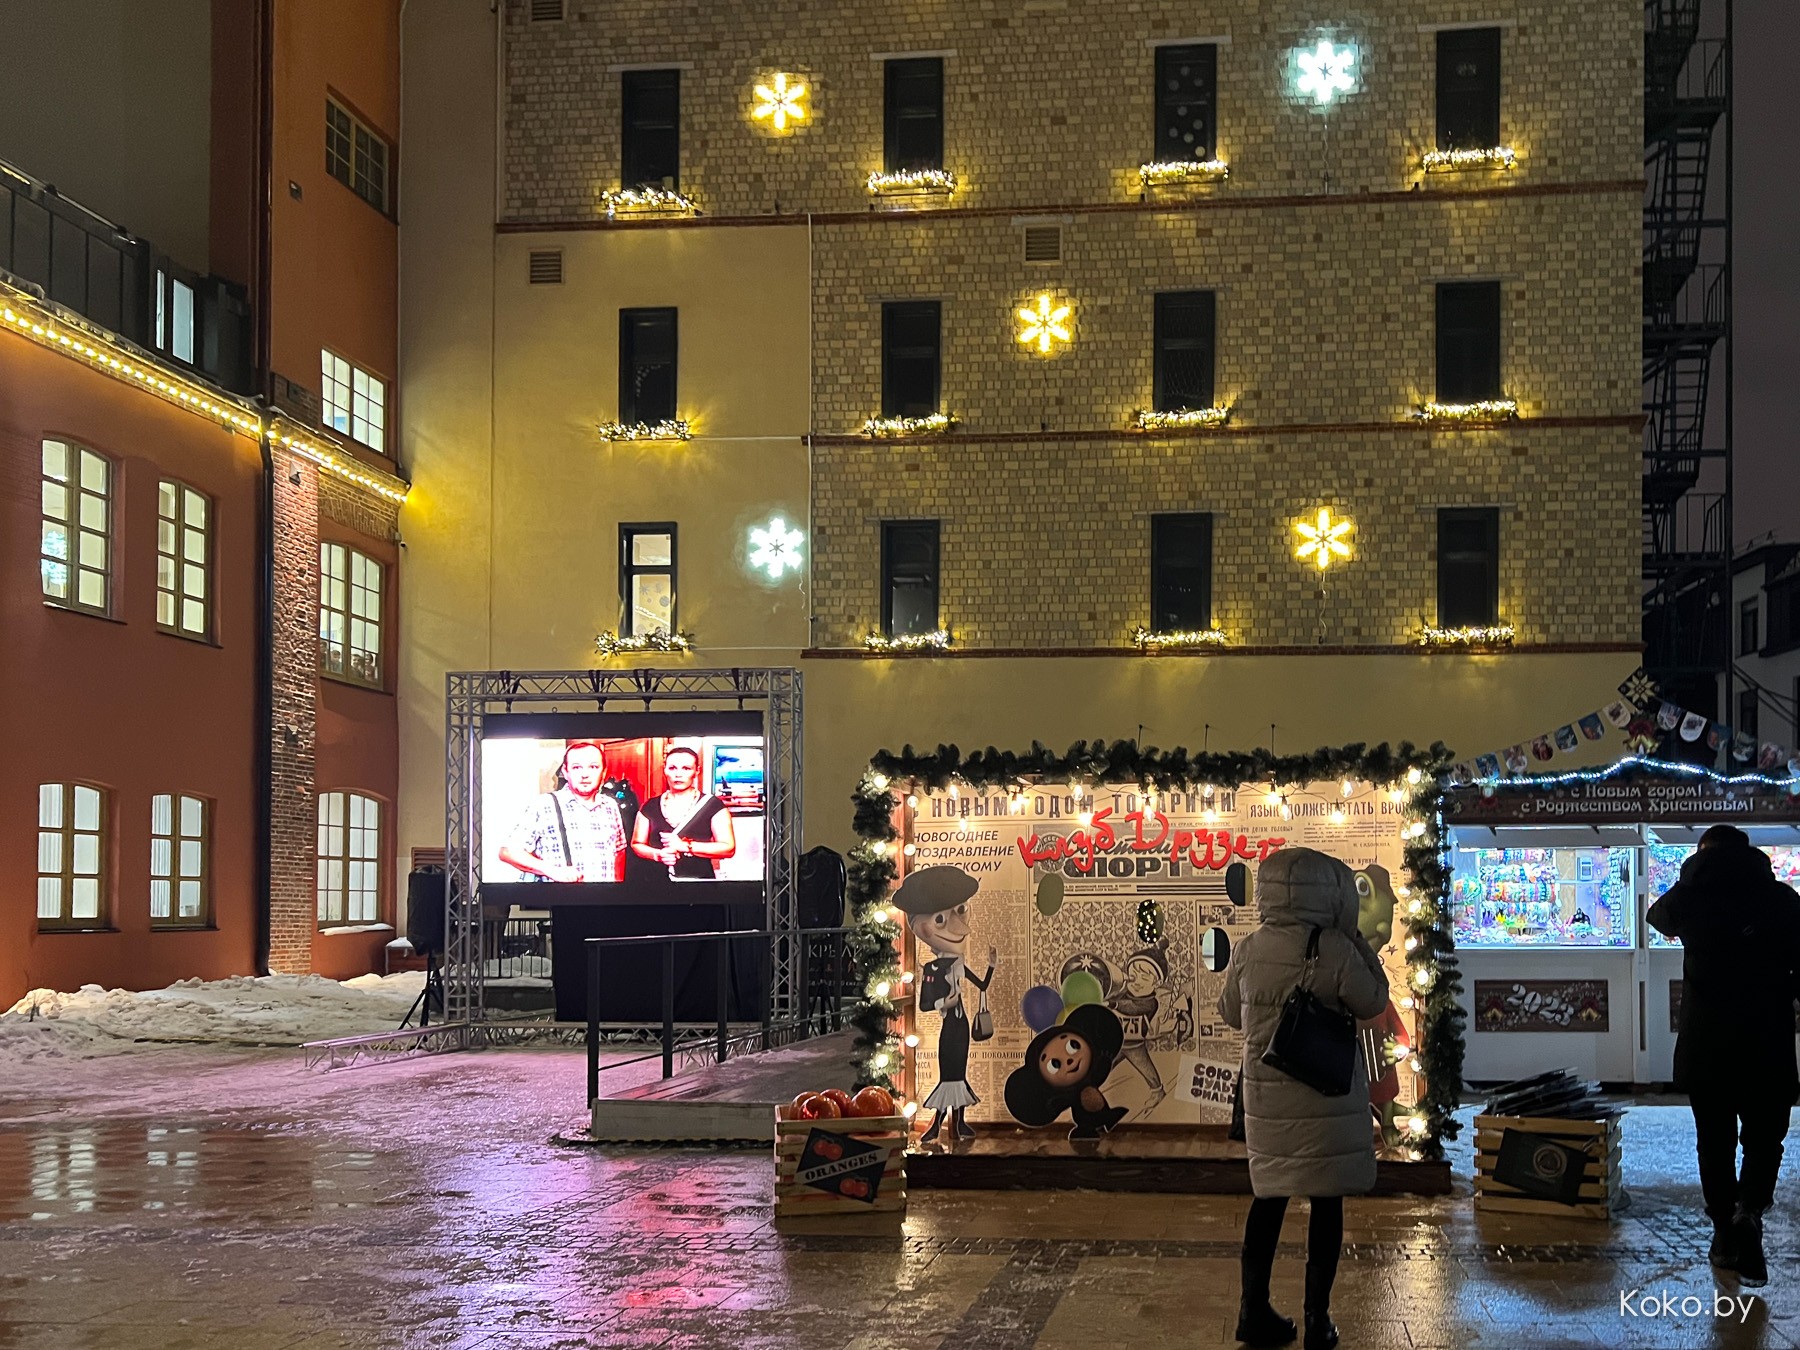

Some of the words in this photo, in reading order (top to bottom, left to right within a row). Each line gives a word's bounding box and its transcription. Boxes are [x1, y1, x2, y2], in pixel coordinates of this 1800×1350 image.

[1586, 784, 1641, 798] Новым
[1647, 784, 1702, 800] годом!
[932, 796, 1008, 817] НОВЫМ
[1648, 797, 1754, 814] Христовым!
[914, 830, 998, 843] НОВОГОДНЕЕ
[915, 845, 1014, 860] ПОЗДРАВЛЕНИЕ
[1506, 983, 1575, 1027] 2023
[1122, 1016, 1139, 1034] 75
[805, 1152, 878, 1181] ORANGES
